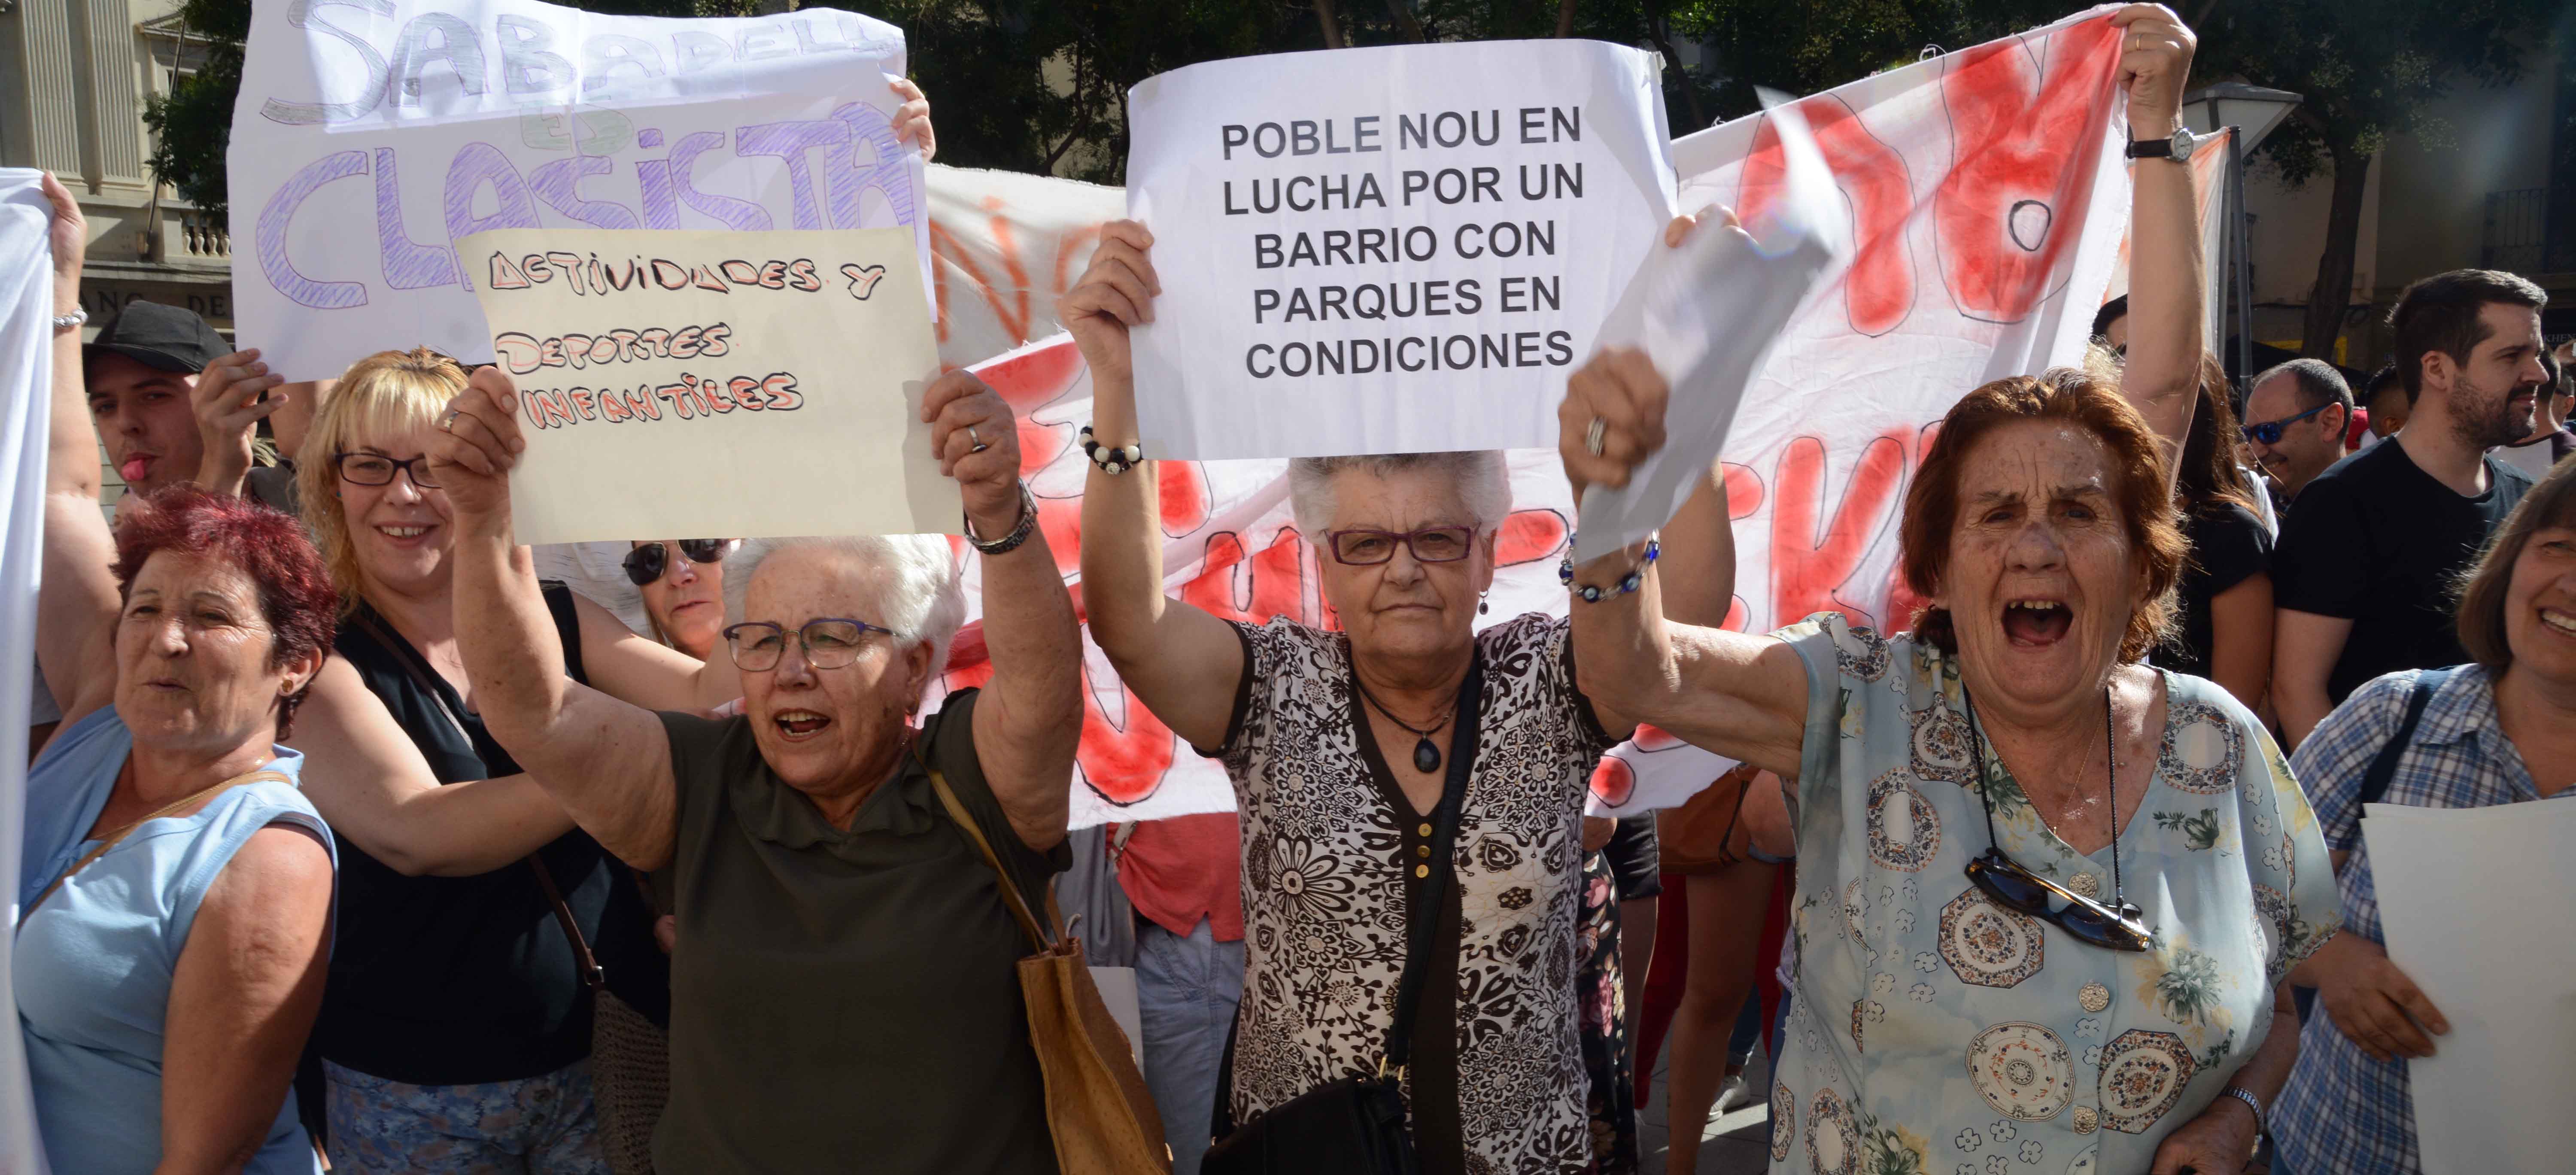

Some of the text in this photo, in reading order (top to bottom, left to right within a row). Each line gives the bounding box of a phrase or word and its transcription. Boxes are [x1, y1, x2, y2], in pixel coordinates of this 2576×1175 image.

[1221, 106, 1581, 161] POBLE NOU EN
[1224, 162, 1583, 216] LUCHA POR UN
[1255, 220, 1555, 269] BARRIO CON
[186, 294, 228, 317] DE
[840, 263, 886, 301] Y
[1254, 275, 1561, 324] PARQUES EN
[1246, 330, 1574, 379] CONDICIONES
